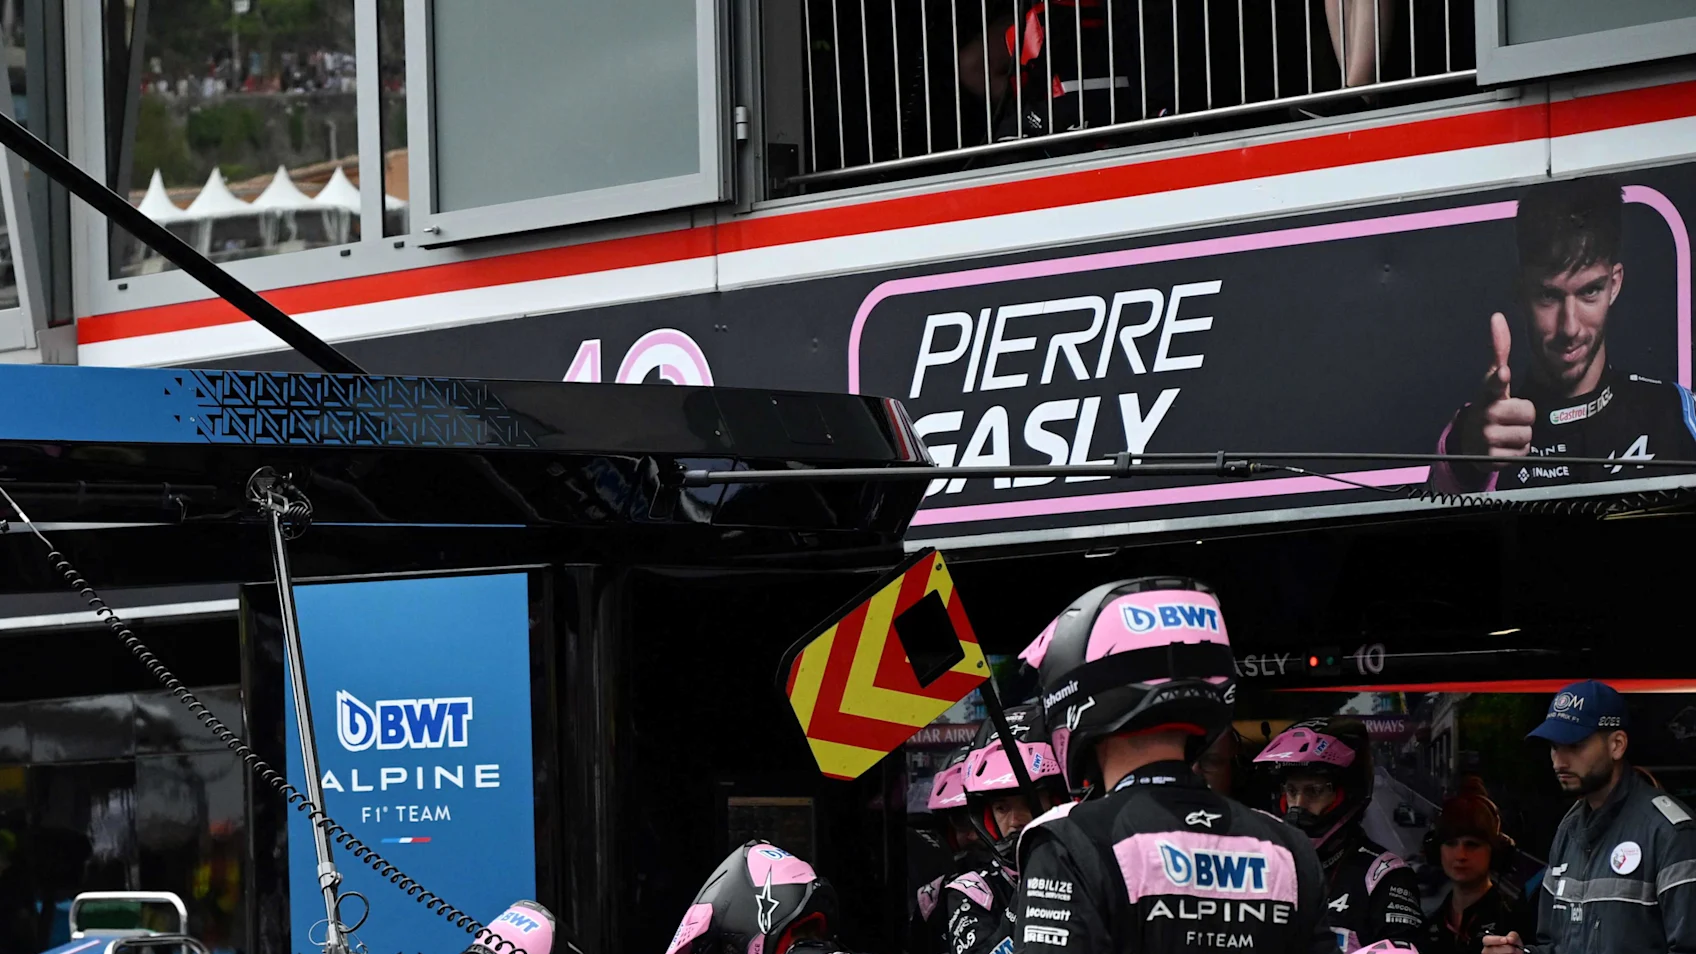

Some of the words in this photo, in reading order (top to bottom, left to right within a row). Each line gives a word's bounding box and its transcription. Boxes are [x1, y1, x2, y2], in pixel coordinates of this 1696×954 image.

[910, 280, 1222, 398] PIERRE
[915, 387, 1181, 496] GASLY
[1157, 604, 1220, 633] BWT
[1354, 643, 1386, 675] 10
[378, 699, 472, 749] BWT
[321, 764, 501, 793] ALPINE
[396, 805, 452, 823] TEAM
[1193, 850, 1268, 893] BWT
[1146, 899, 1291, 925] ALPINE
[1207, 931, 1254, 948] TEAM
